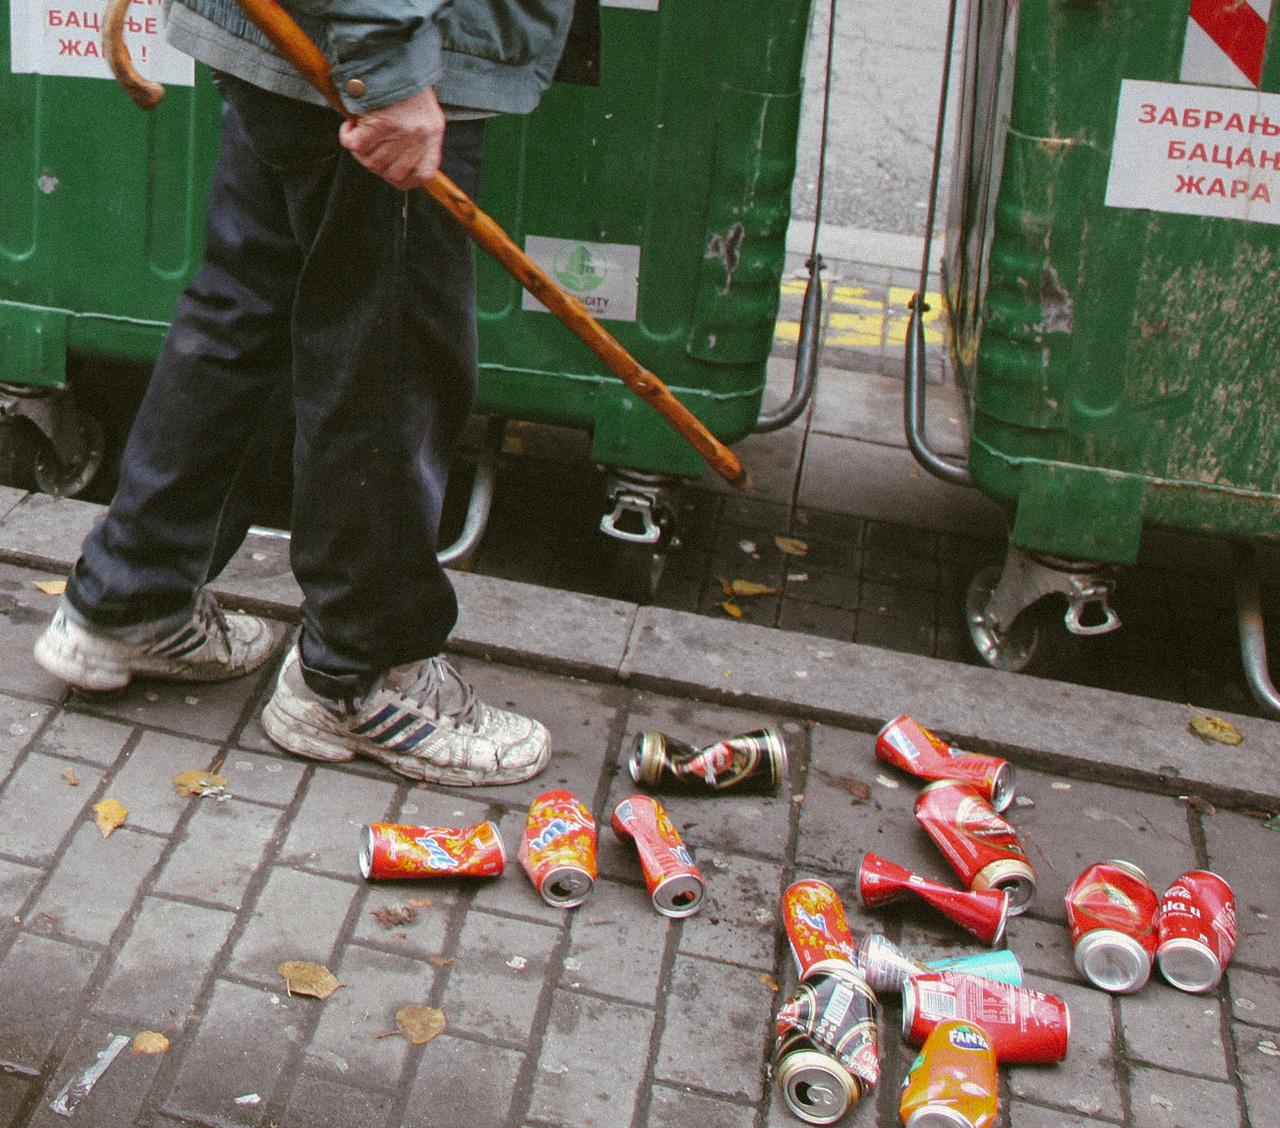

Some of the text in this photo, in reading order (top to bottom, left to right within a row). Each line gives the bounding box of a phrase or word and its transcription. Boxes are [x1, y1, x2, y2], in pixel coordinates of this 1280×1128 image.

[48, 9, 158, 35] БАЦЊЕ
[1138, 103, 1280, 137] ЗАБРАЊ
[1174, 173, 1271, 203] ЖАРА
